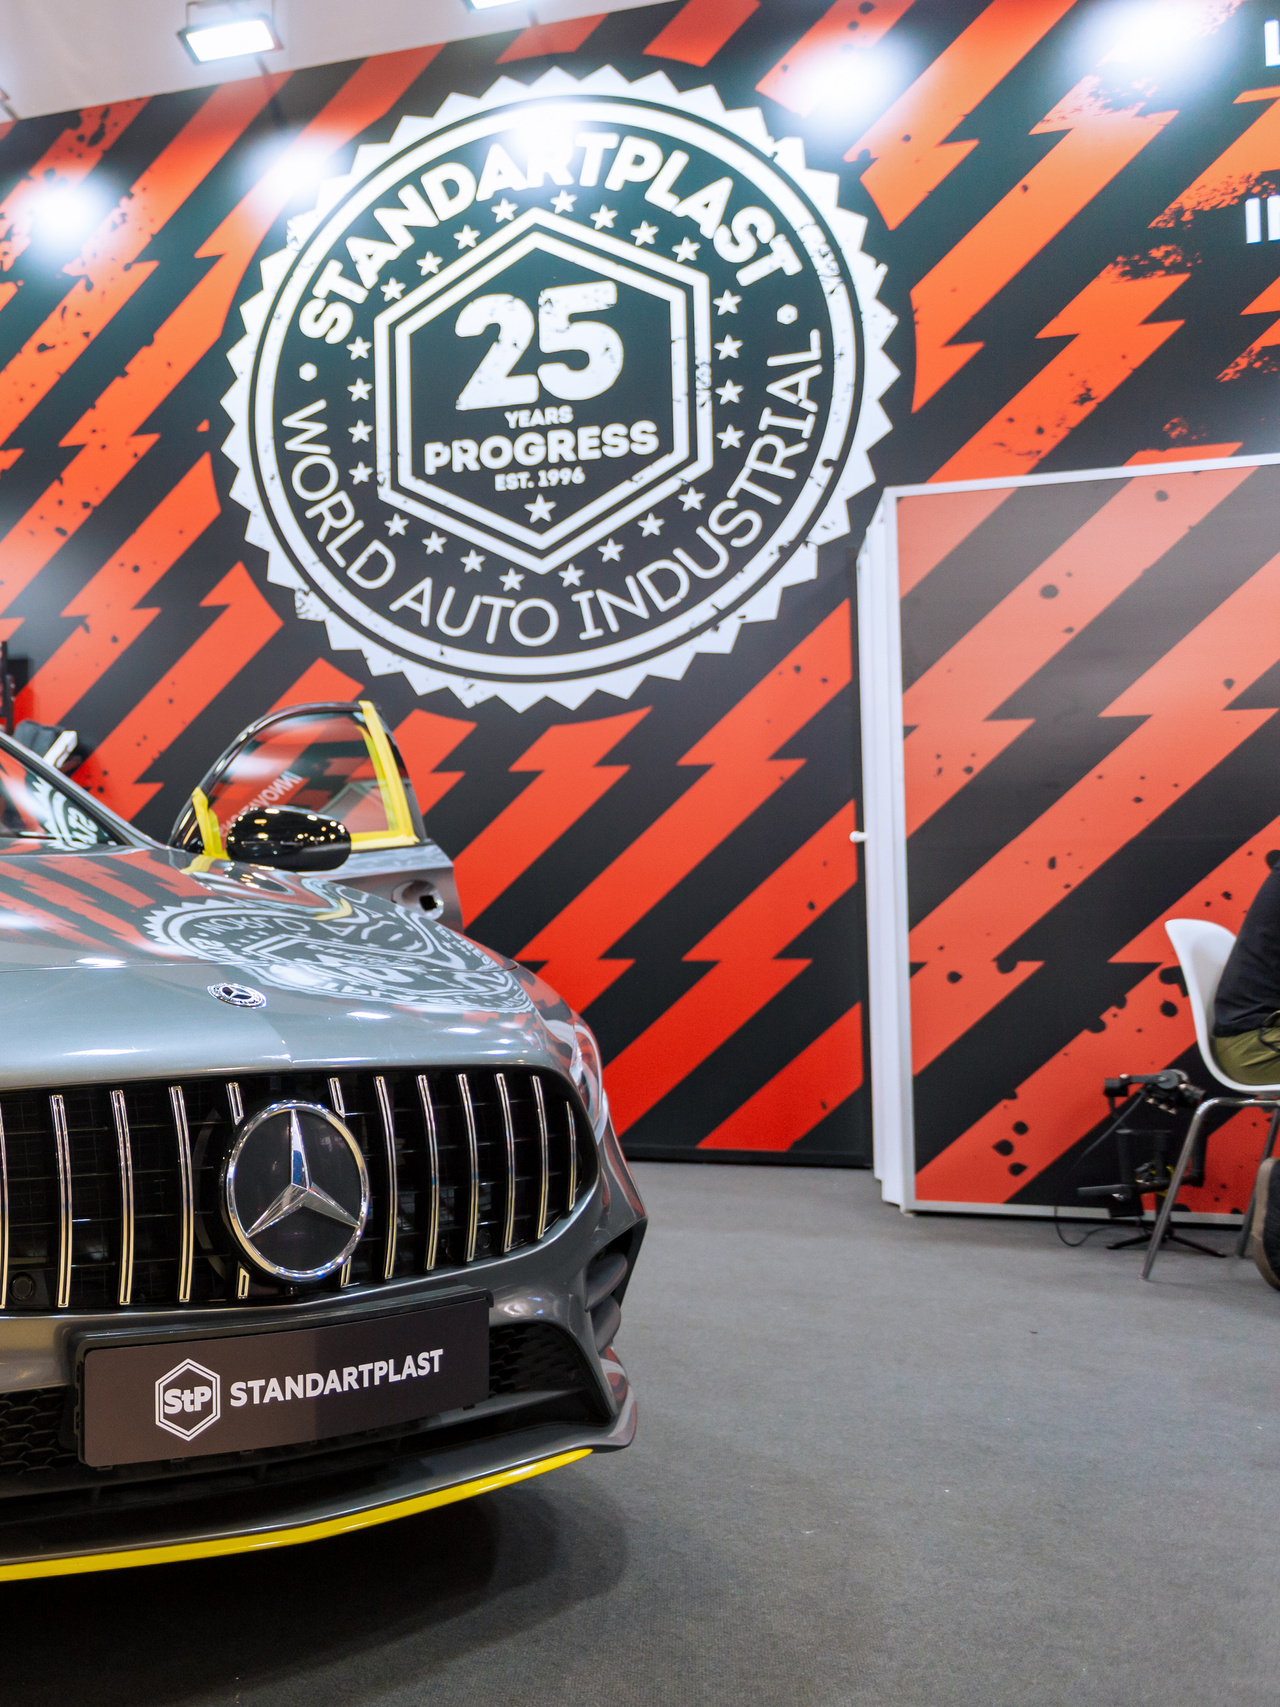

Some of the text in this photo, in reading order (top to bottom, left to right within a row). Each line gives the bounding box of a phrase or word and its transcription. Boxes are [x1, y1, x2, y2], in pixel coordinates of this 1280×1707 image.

[299, 131, 803, 345] STANDARTPLAST
[454, 280, 625, 411] 25
[424, 420, 660, 475] PROGRESS
[504, 404, 574, 429] YEARS
[281, 328, 823, 647] WORLD AUTO INDUSTRIAL
[494, 466, 586, 491] EST. 1996
[163, 1348, 444, 1415] StP STANDARTPLAST
